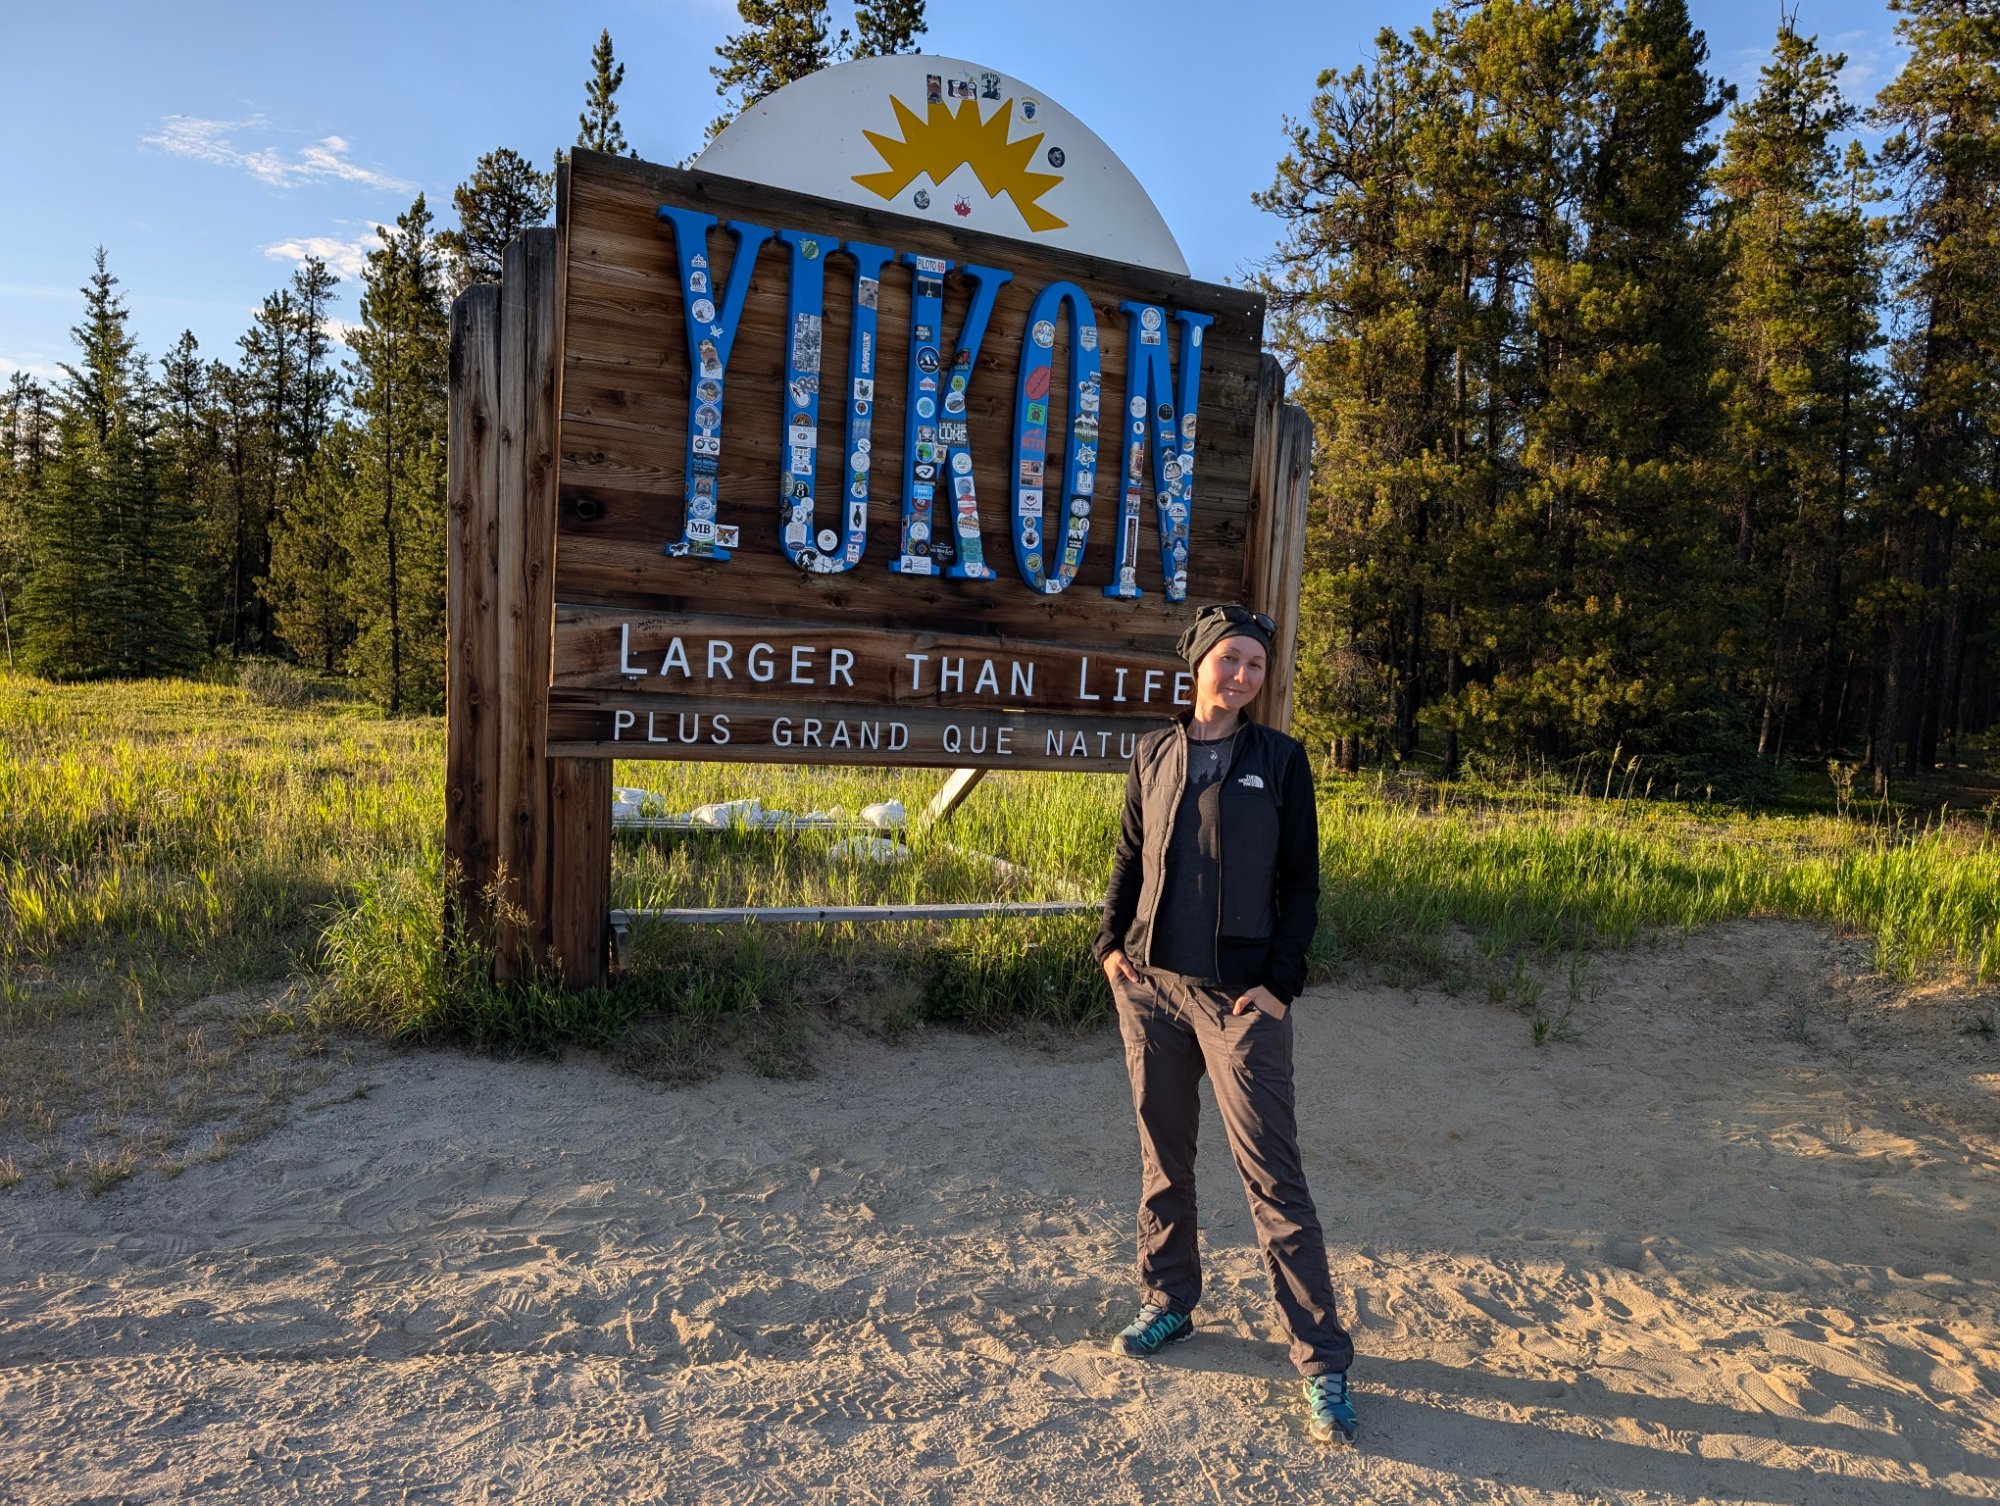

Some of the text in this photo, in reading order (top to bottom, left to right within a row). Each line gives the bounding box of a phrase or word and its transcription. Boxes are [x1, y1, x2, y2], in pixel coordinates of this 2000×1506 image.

[918, 258, 937, 271] PILOTO
[657, 205, 1215, 602] YUKON
[939, 428, 967, 441] LUKE
[691, 522, 711, 534] MB
[620, 623, 854, 687] LARGER
[905, 653, 1034, 697] THAN
[1079, 656, 1192, 705] LIFE
[613, 709, 1136, 759] PLUS GRAND QUE NATU
